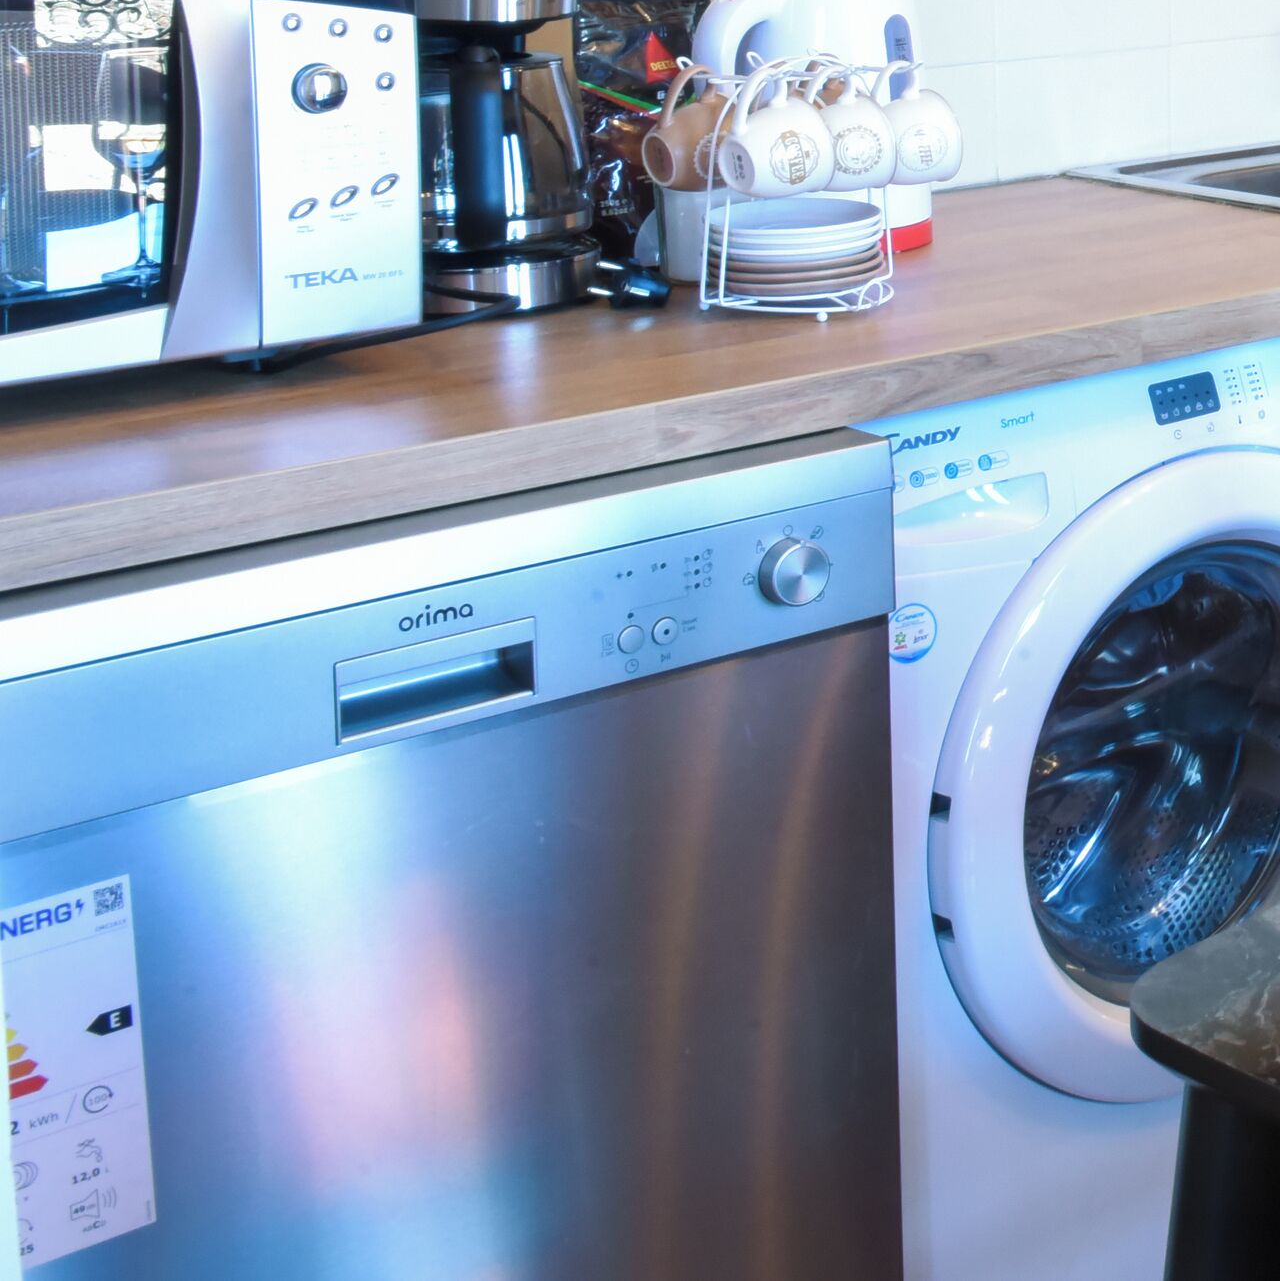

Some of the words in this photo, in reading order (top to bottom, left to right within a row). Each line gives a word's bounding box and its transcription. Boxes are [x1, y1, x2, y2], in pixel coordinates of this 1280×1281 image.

[284, 267, 359, 289] TEKA
[1001, 411, 1035, 428] Smart
[398, 603, 474, 632] orima
[109, 1010, 122, 1030] E
[29, 1112, 60, 1129] kWh
[72, 1167, 100, 1185] 12,0
